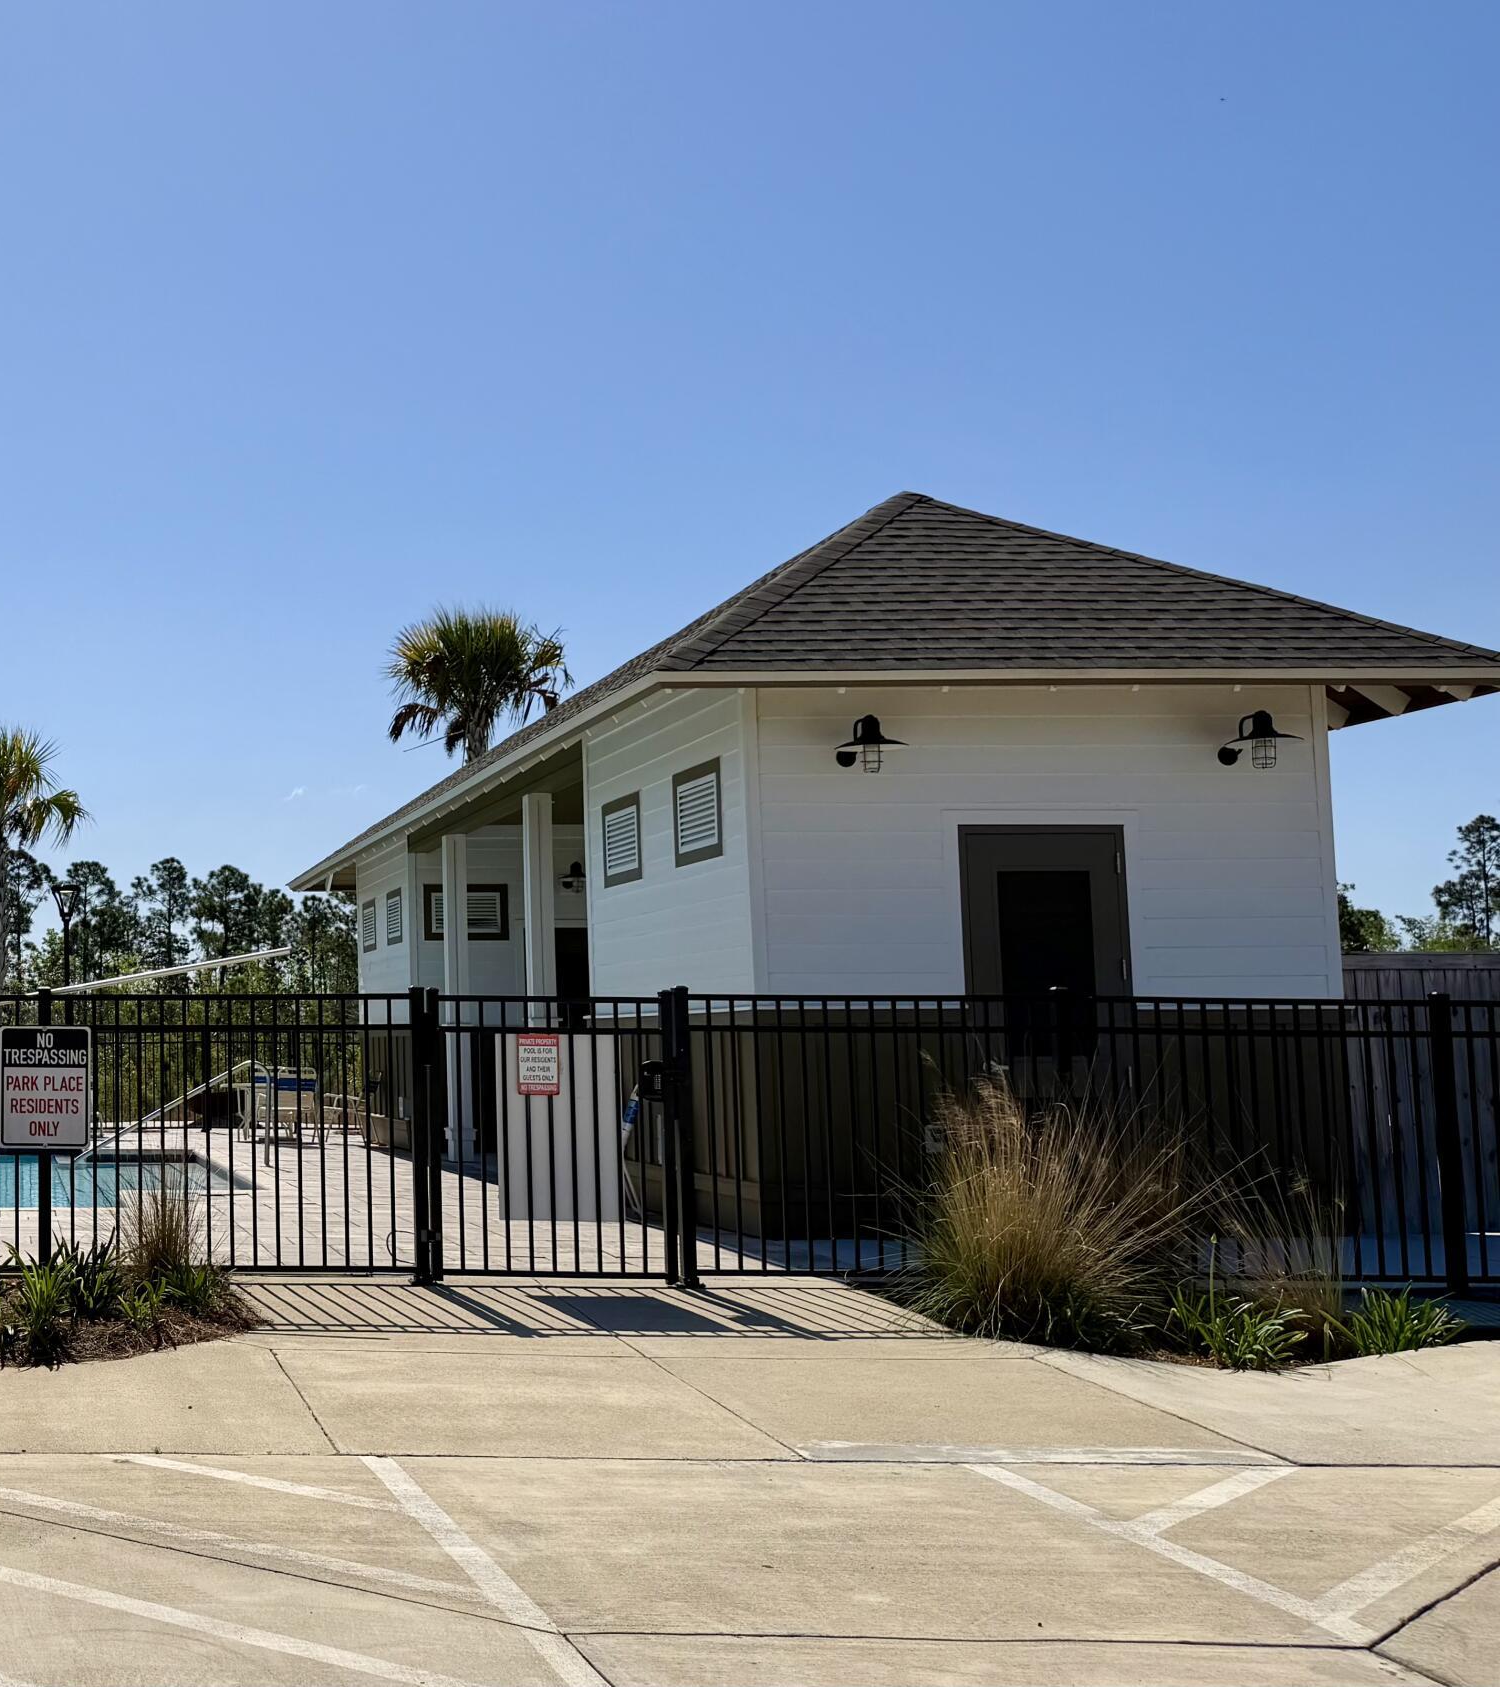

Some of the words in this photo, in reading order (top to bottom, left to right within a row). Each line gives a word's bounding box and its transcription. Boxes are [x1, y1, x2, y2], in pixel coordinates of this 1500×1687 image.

[36, 1033, 53, 1048] NO
[4, 1049, 87, 1065] TRESPASSING
[6, 1075, 39, 1091] PARK
[43, 1076, 84, 1092] PLACE
[10, 1098, 79, 1115] RESIDENTS
[29, 1120, 60, 1137] ONLY
